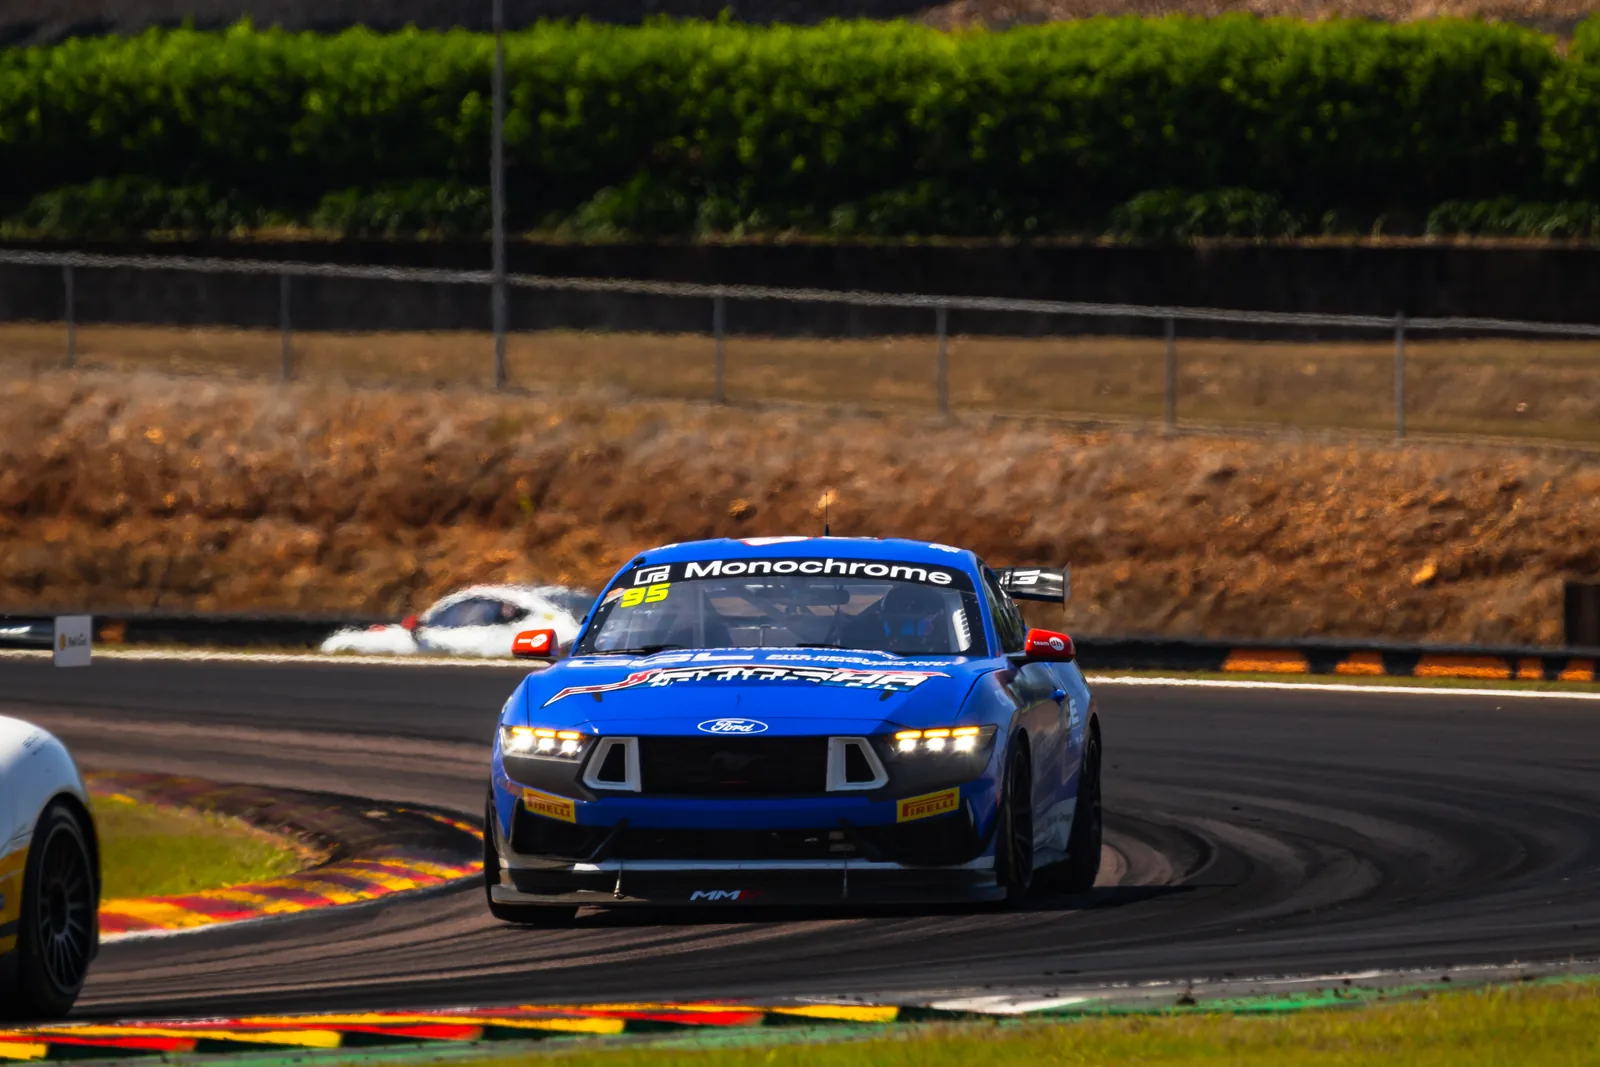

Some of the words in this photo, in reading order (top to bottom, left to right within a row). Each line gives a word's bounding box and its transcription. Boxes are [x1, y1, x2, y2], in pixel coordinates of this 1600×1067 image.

[684, 558, 953, 585] Monochrome
[620, 583, 671, 608] 95
[711, 720, 755, 732] Ford
[527, 792, 571, 818] PIRELLI
[902, 793, 955, 817] PIRELLI
